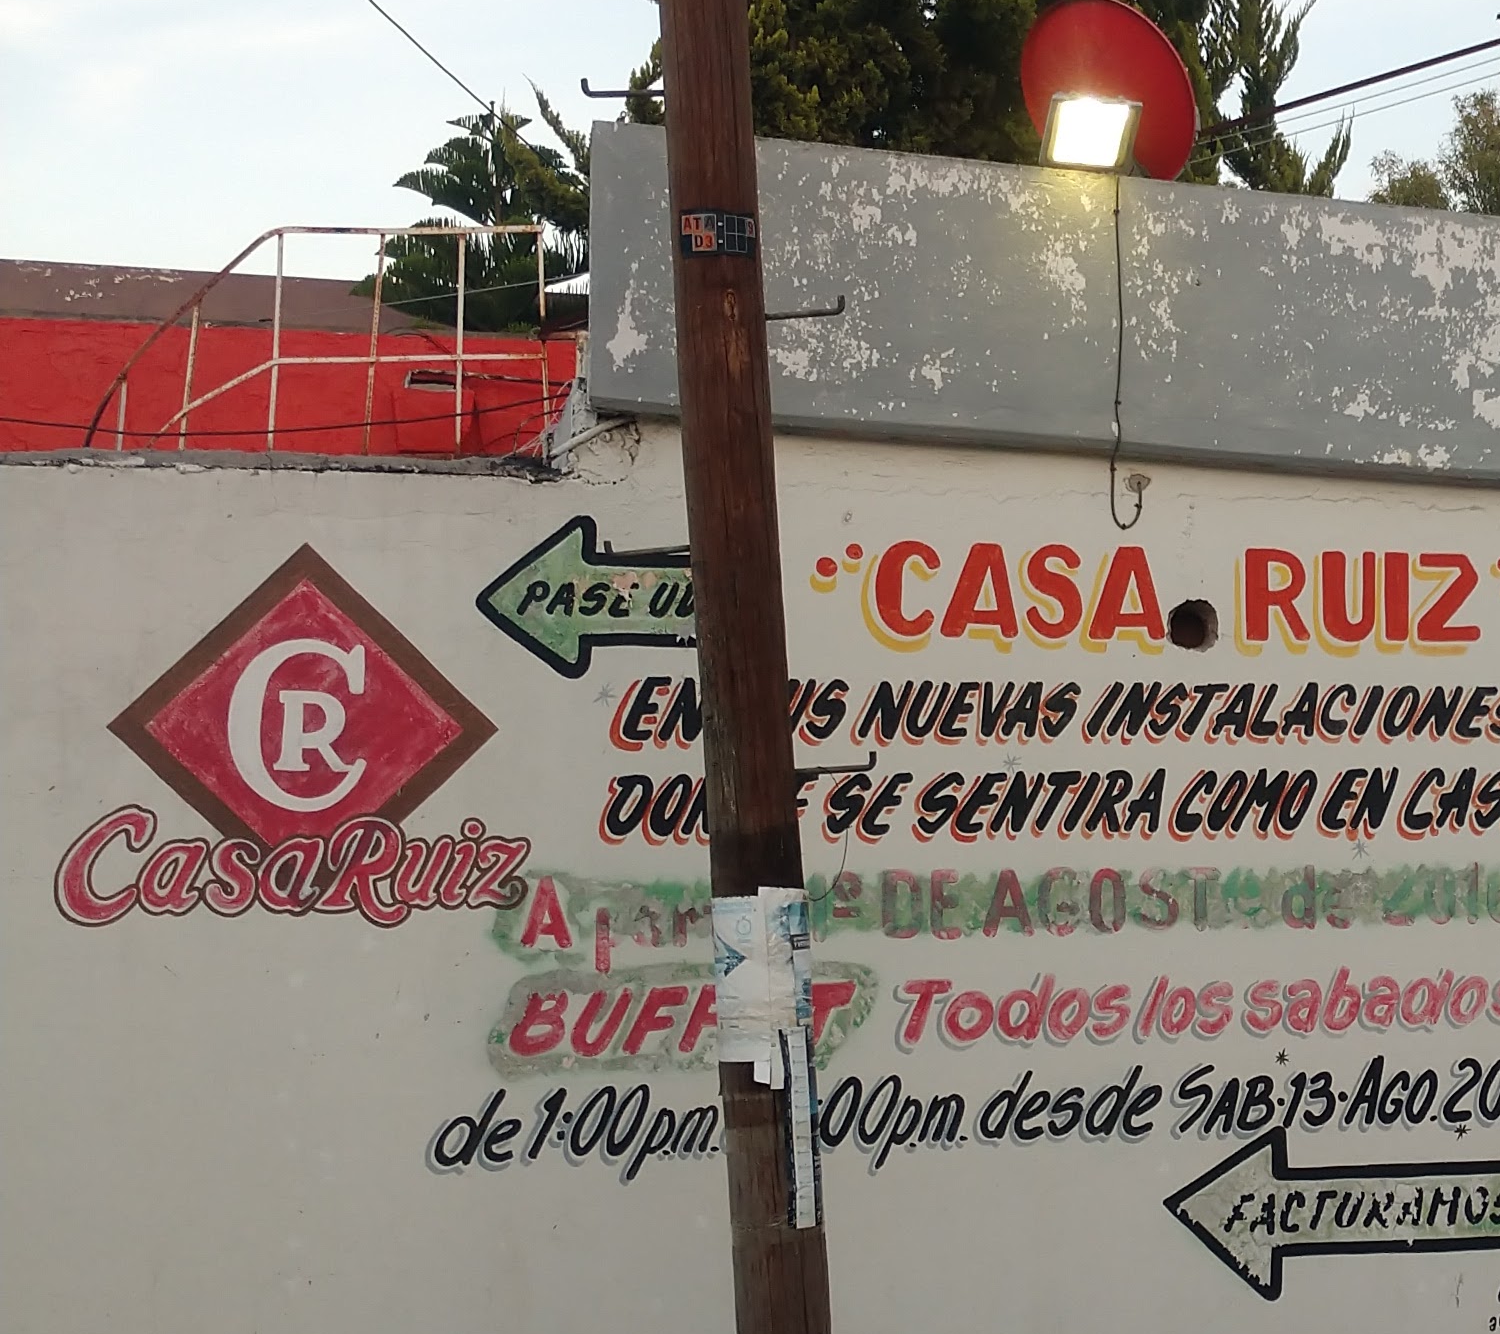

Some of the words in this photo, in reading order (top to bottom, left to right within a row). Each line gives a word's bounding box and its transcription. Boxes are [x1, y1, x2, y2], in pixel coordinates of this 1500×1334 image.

[870, 540, 1166, 645] CASA
[1240, 547, 1482, 647] RUIZ
[857, 680, 1082, 743] NUEVAS
[824, 771, 913, 839] SE
[916, 768, 1167, 838] SENTIRA
[1171, 767, 1318, 837] COMO
[1320, 766, 1400, 836] EN
[520, 875, 573, 948] A
[881, 868, 963, 941] DE
[509, 982, 857, 1058] BUFFT
[900, 971, 1131, 1045] Todos
[1137, 974, 1234, 1038] los
[432, 1088, 523, 1168] de
[815, 1074, 969, 1171] :00p.m.
[978, 1065, 1162, 1141] desde
